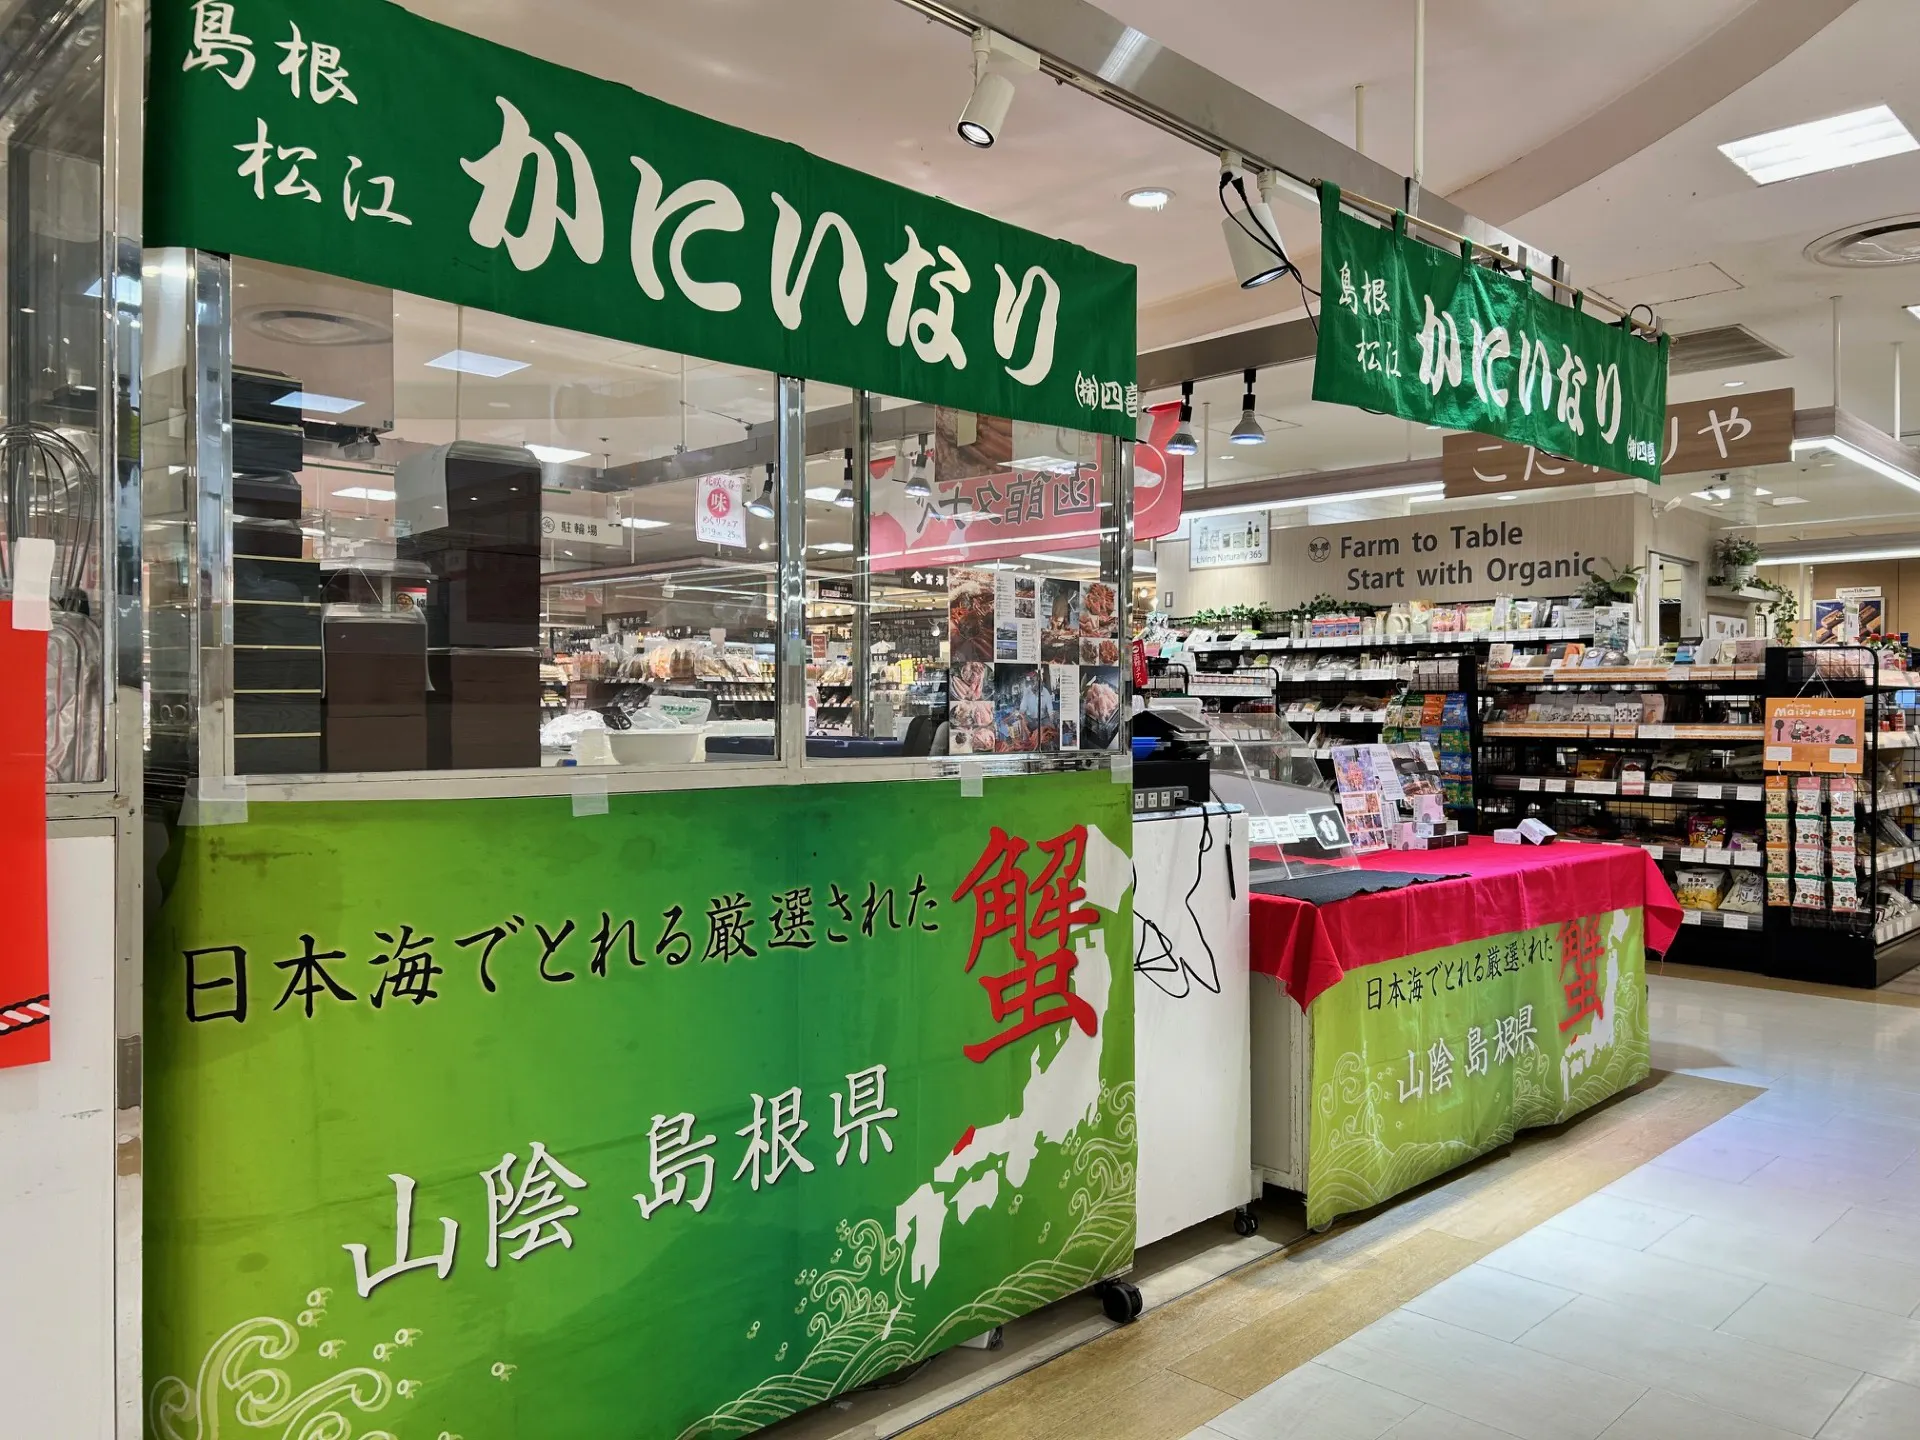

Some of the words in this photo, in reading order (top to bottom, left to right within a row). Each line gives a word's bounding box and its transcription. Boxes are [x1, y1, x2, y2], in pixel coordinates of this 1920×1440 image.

[184, 0, 358, 105] 島根
[233, 117, 412, 226] 松江
[461, 96, 1061, 386] かにいなり
[1339, 261, 1391, 316] 島根
[1355, 337, 1403, 379] 松江
[1416, 294, 1622, 444] かにいなり
[561, 520, 598, 537] 駐輪場
[1196, 554, 1217, 565] Living
[1249, 549, 1263, 560] 365
[1340, 535, 1400, 560] Farm
[1411, 531, 1438, 553] to
[1449, 520, 1523, 550] Table
[1347, 566, 1405, 591] Start
[1416, 559, 1474, 587] with
[1487, 551, 1596, 585] Organic
[184, 873, 940, 1023] 日本海でとれる厳選された
[954, 825, 1098, 1063] 蟹
[1556, 913, 1605, 1032] 蟹
[1397, 1037, 1455, 1104] 山陰
[1464, 1003, 1538, 1077] 島根県
[343, 1141, 588, 1299] 山陰
[630, 1063, 900, 1222] 島根県
